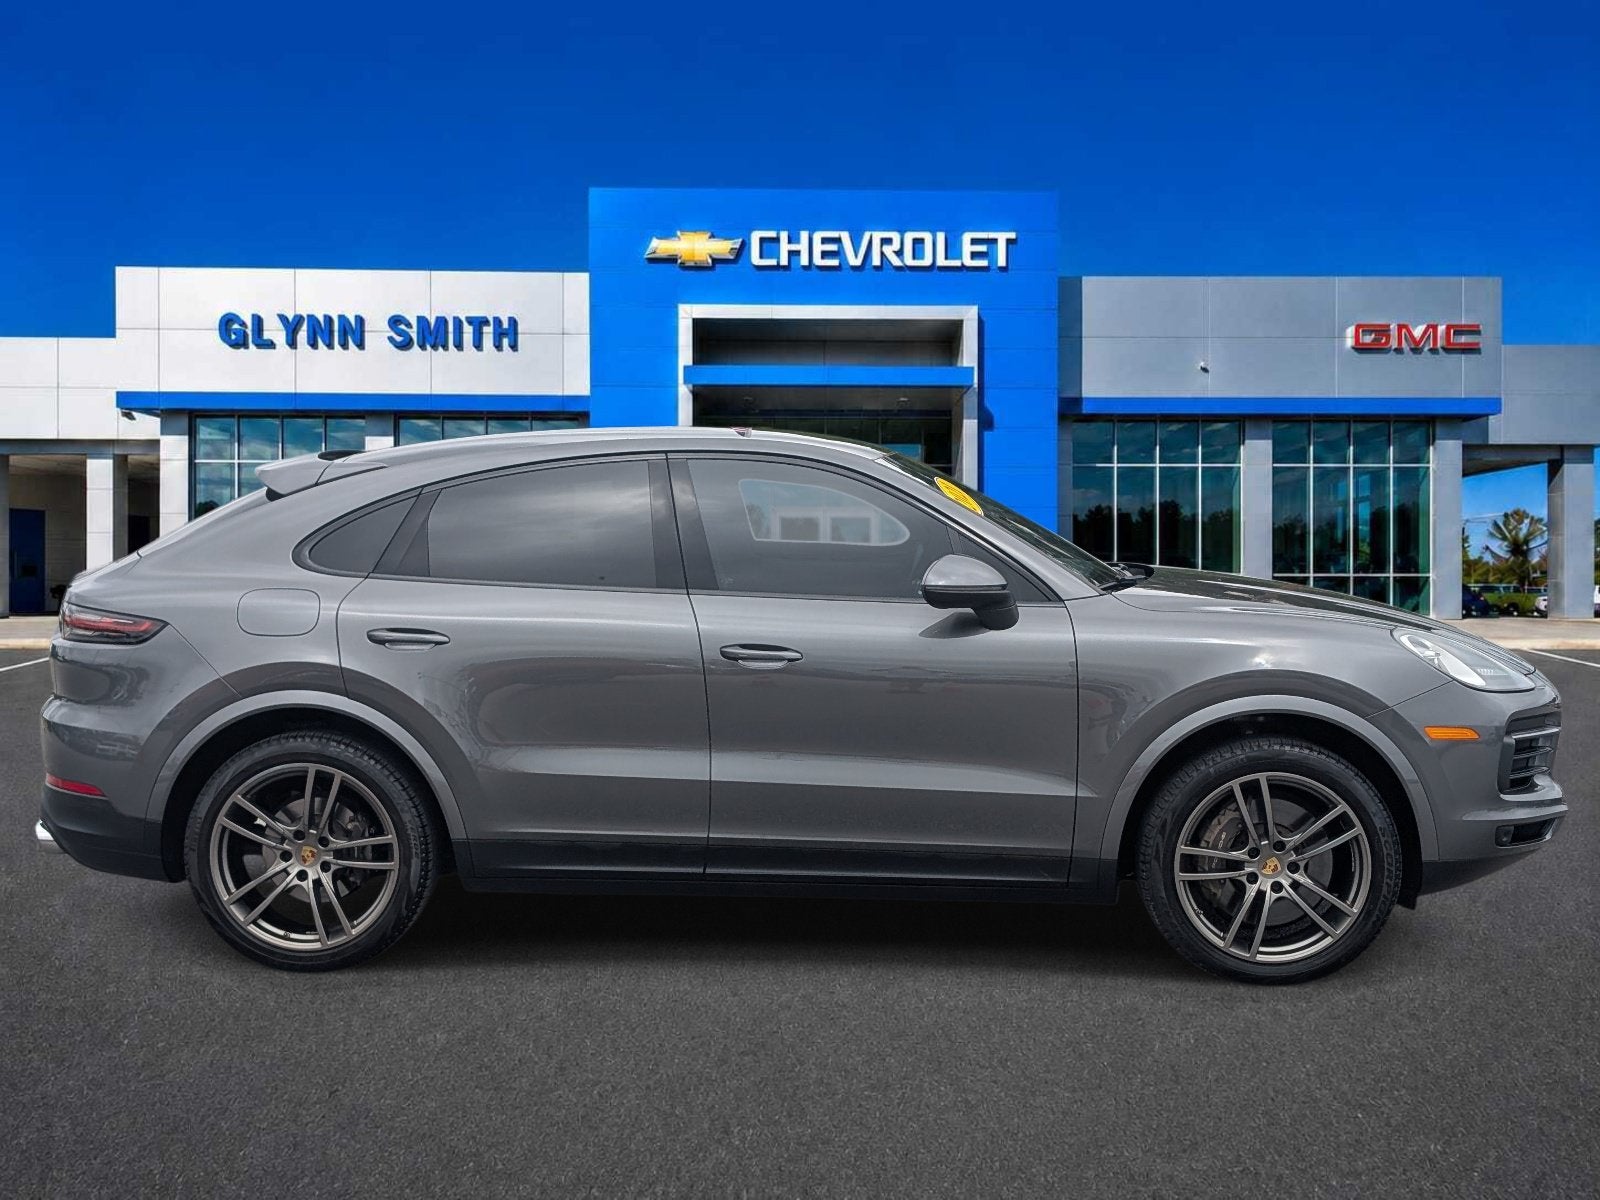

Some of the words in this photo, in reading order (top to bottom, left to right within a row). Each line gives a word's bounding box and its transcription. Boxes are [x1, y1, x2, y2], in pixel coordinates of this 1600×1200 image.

[750, 229, 1017, 268] CHEVROLET
[218, 312, 366, 350] GLYNN
[386, 313, 519, 351] SMITH
[1348, 322, 1482, 351] GMC
